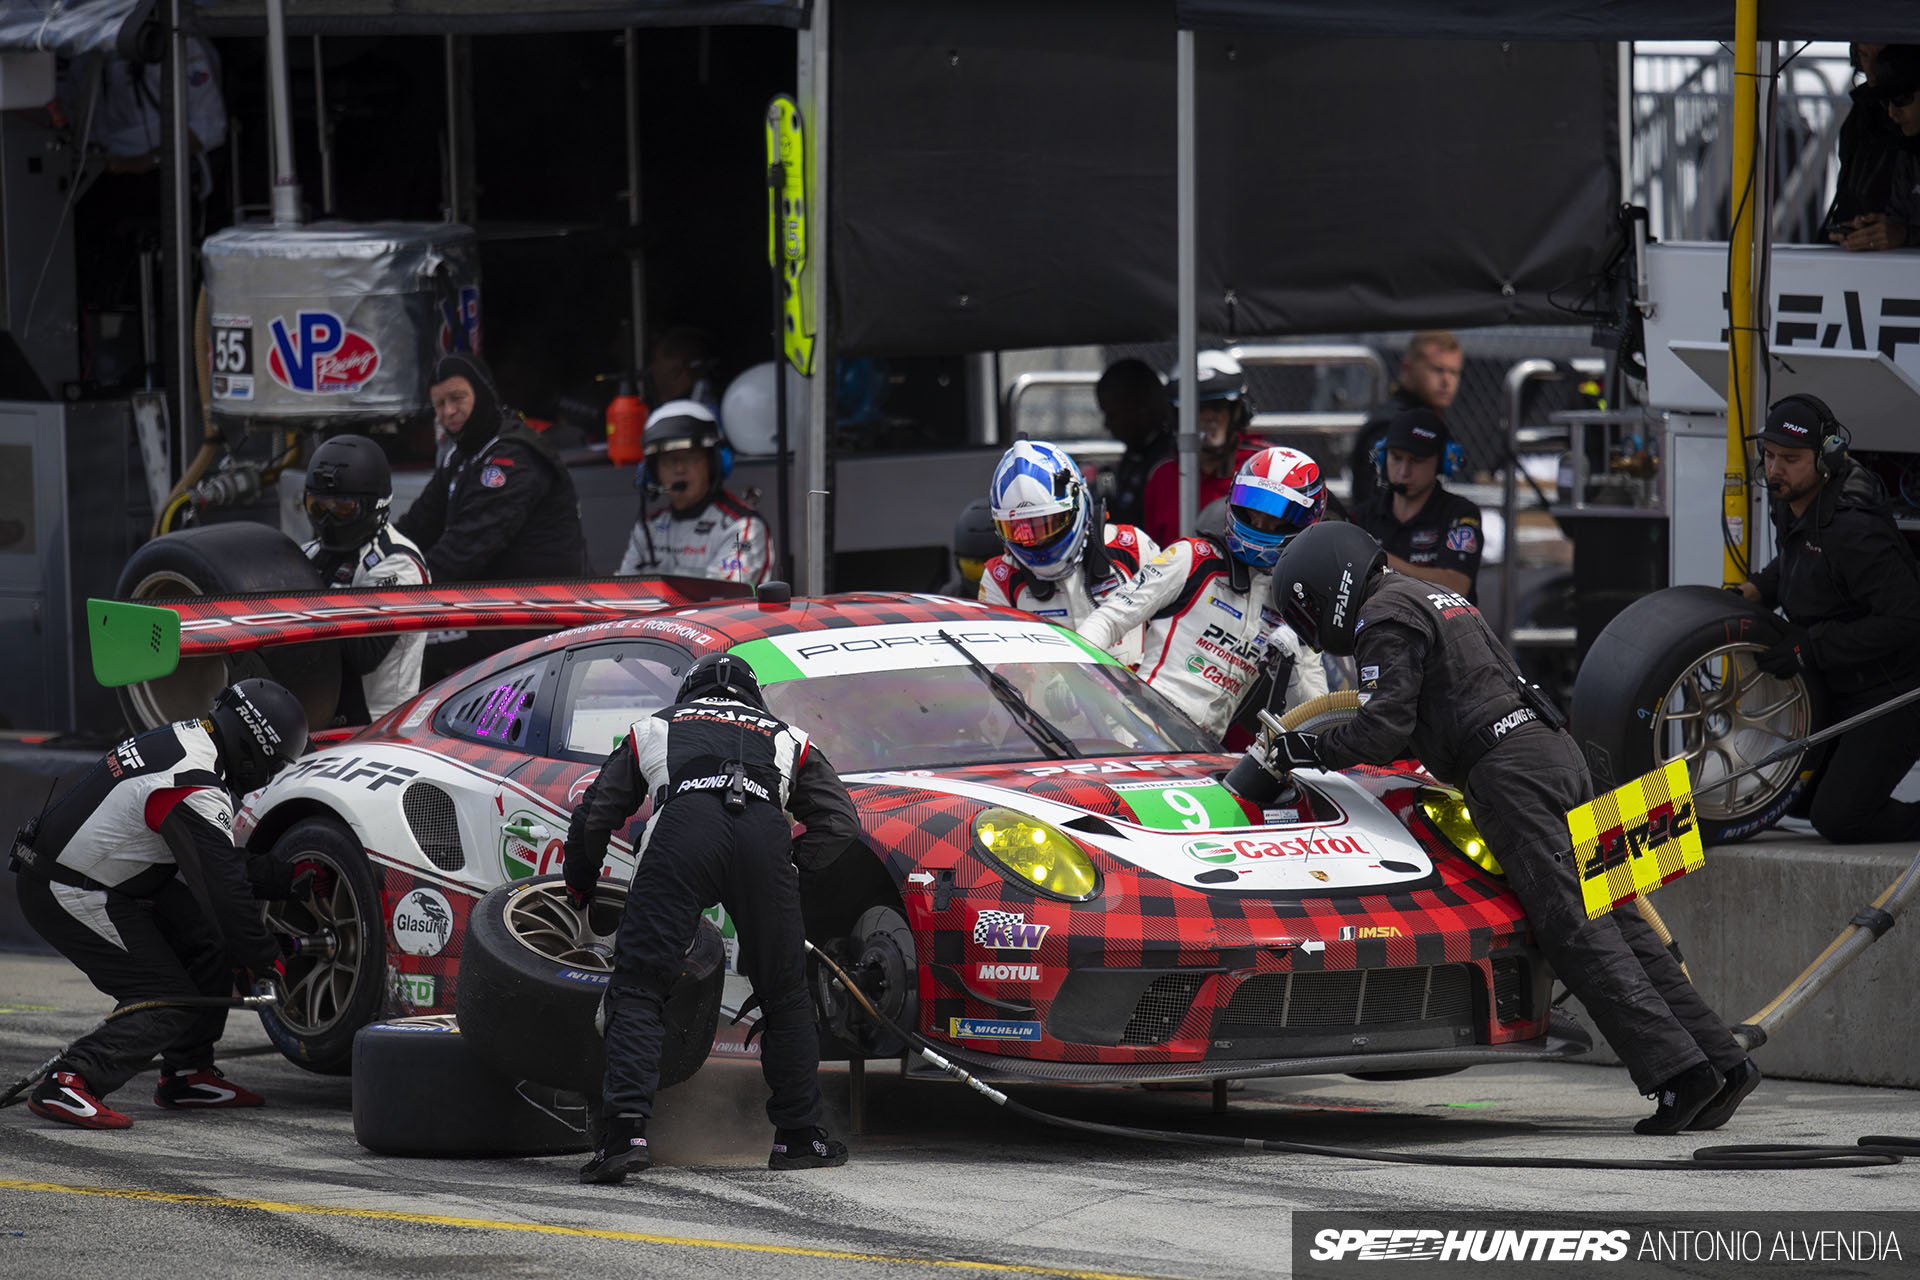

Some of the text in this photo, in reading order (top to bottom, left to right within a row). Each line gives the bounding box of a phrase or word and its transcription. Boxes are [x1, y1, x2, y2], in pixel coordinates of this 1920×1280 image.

[216, 330, 246, 372] 55
[271, 313, 342, 391] VP
[318, 352, 376, 383] Racing
[1783, 422, 1809, 435] PFAFF
[1449, 529, 1472, 550] VP
[1333, 570, 1354, 628] PFAFF
[643, 620, 700, 640] ROBICHON
[796, 632, 1071, 660] PORSCHE
[673, 708, 779, 729] PFAFF
[1493, 709, 1528, 738] RACING
[272, 757, 420, 792] PFAFF
[1024, 760, 1198, 777] PFAFF
[677, 775, 728, 794] RACING
[1161, 789, 1211, 830] 9
[1233, 836, 1370, 859] Castrol
[1583, 801, 1693, 882] PFAFF
[397, 914, 449, 935] Glasurit
[985, 922, 1047, 947] KW
[1358, 926, 1402, 938] IMSA
[566, 971, 611, 983] ELIN
[979, 965, 1041, 980] MOTUL
[974, 1026, 1033, 1035] MICHELIN
